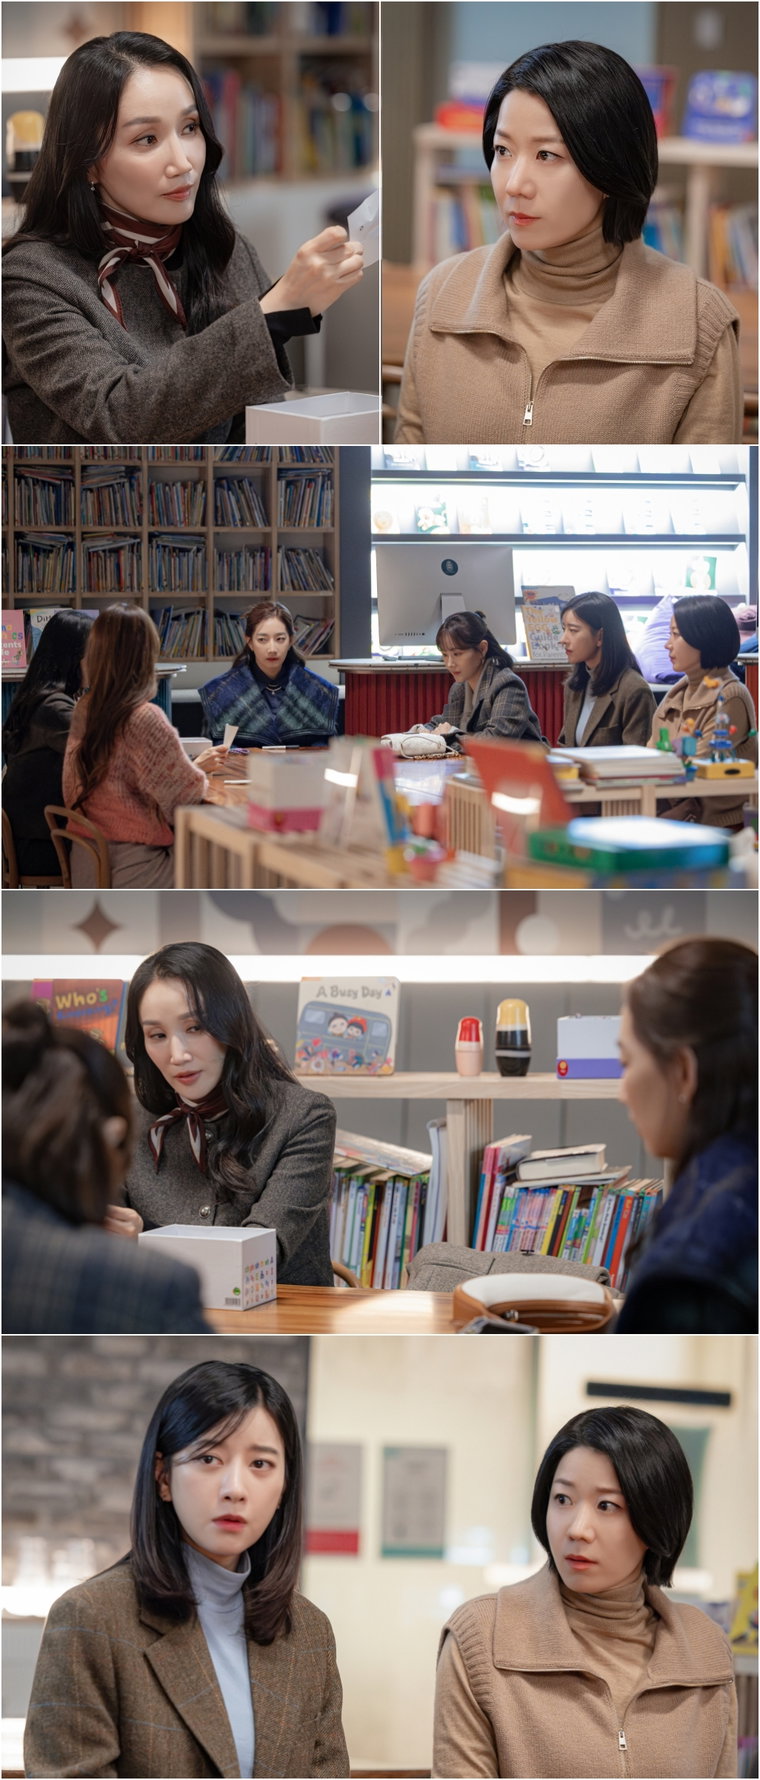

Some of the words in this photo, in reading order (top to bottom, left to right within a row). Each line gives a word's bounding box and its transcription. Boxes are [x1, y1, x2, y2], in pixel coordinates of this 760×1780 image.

[55, 987, 108, 1010] Who's
[316, 986, 327, 998] A
[330, 985, 358, 999] Busy
[361, 986, 383, 999] Day
